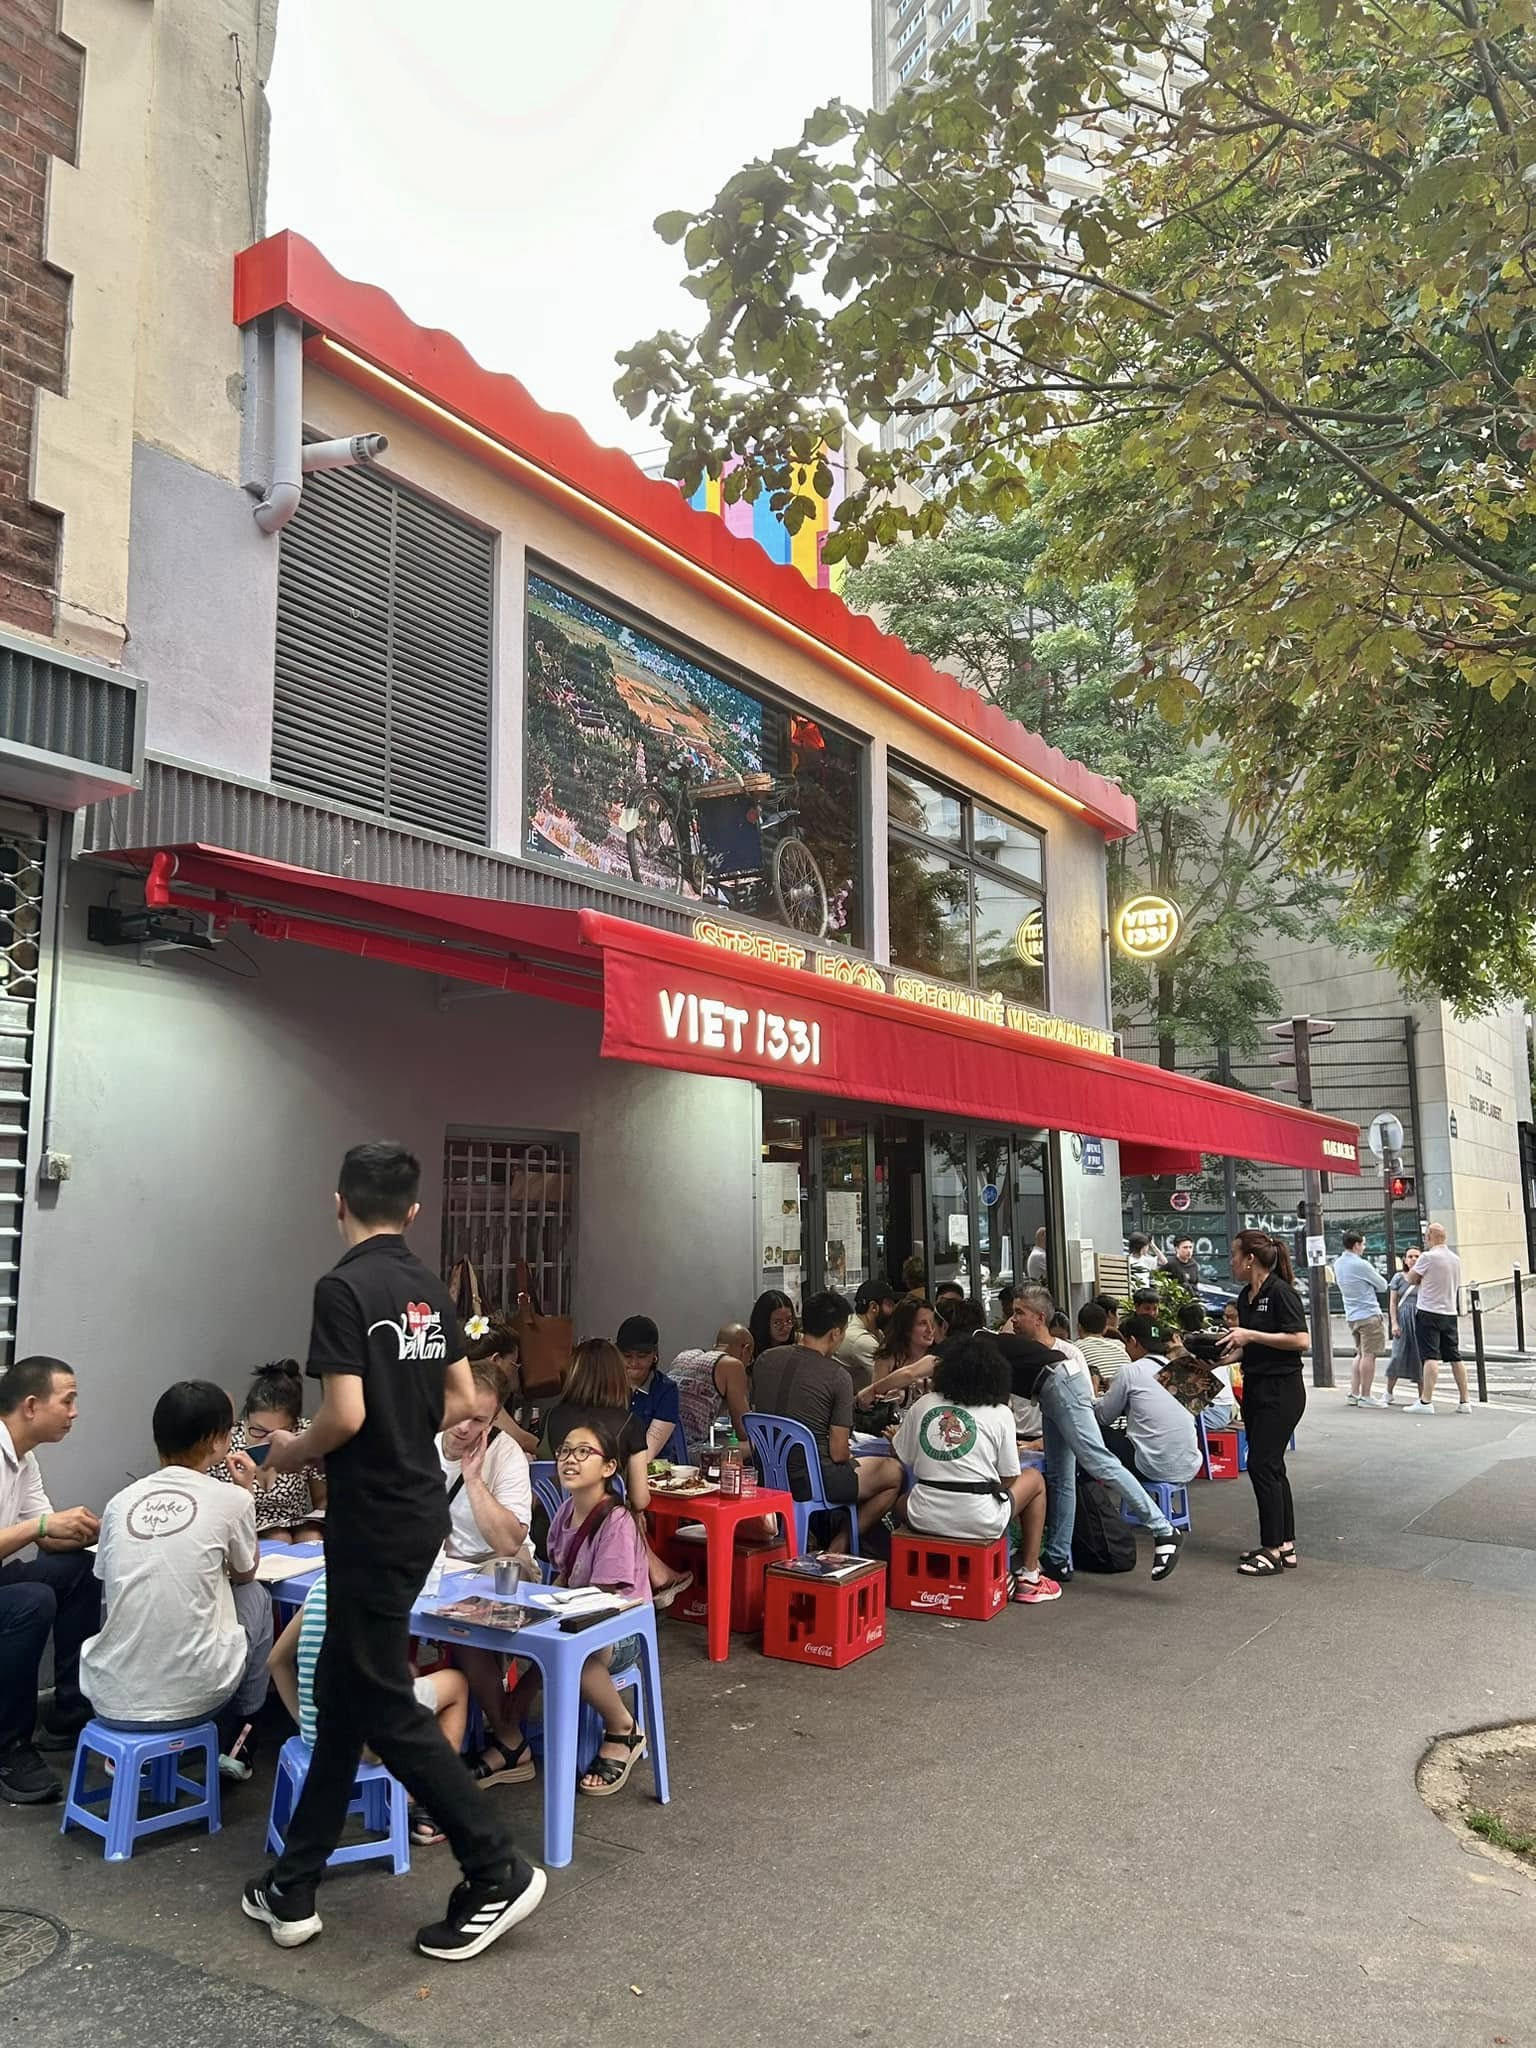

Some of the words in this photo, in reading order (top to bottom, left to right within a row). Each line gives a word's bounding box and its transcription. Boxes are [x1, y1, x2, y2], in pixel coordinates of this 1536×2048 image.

[1125, 907, 1170, 929] VIET
[1126, 925, 1168, 946] 1331
[696, 921, 806, 972] STREET
[816, 951, 886, 994] FOOD
[658, 988, 750, 1053] VIET
[756, 1008, 822, 1066] 1331
